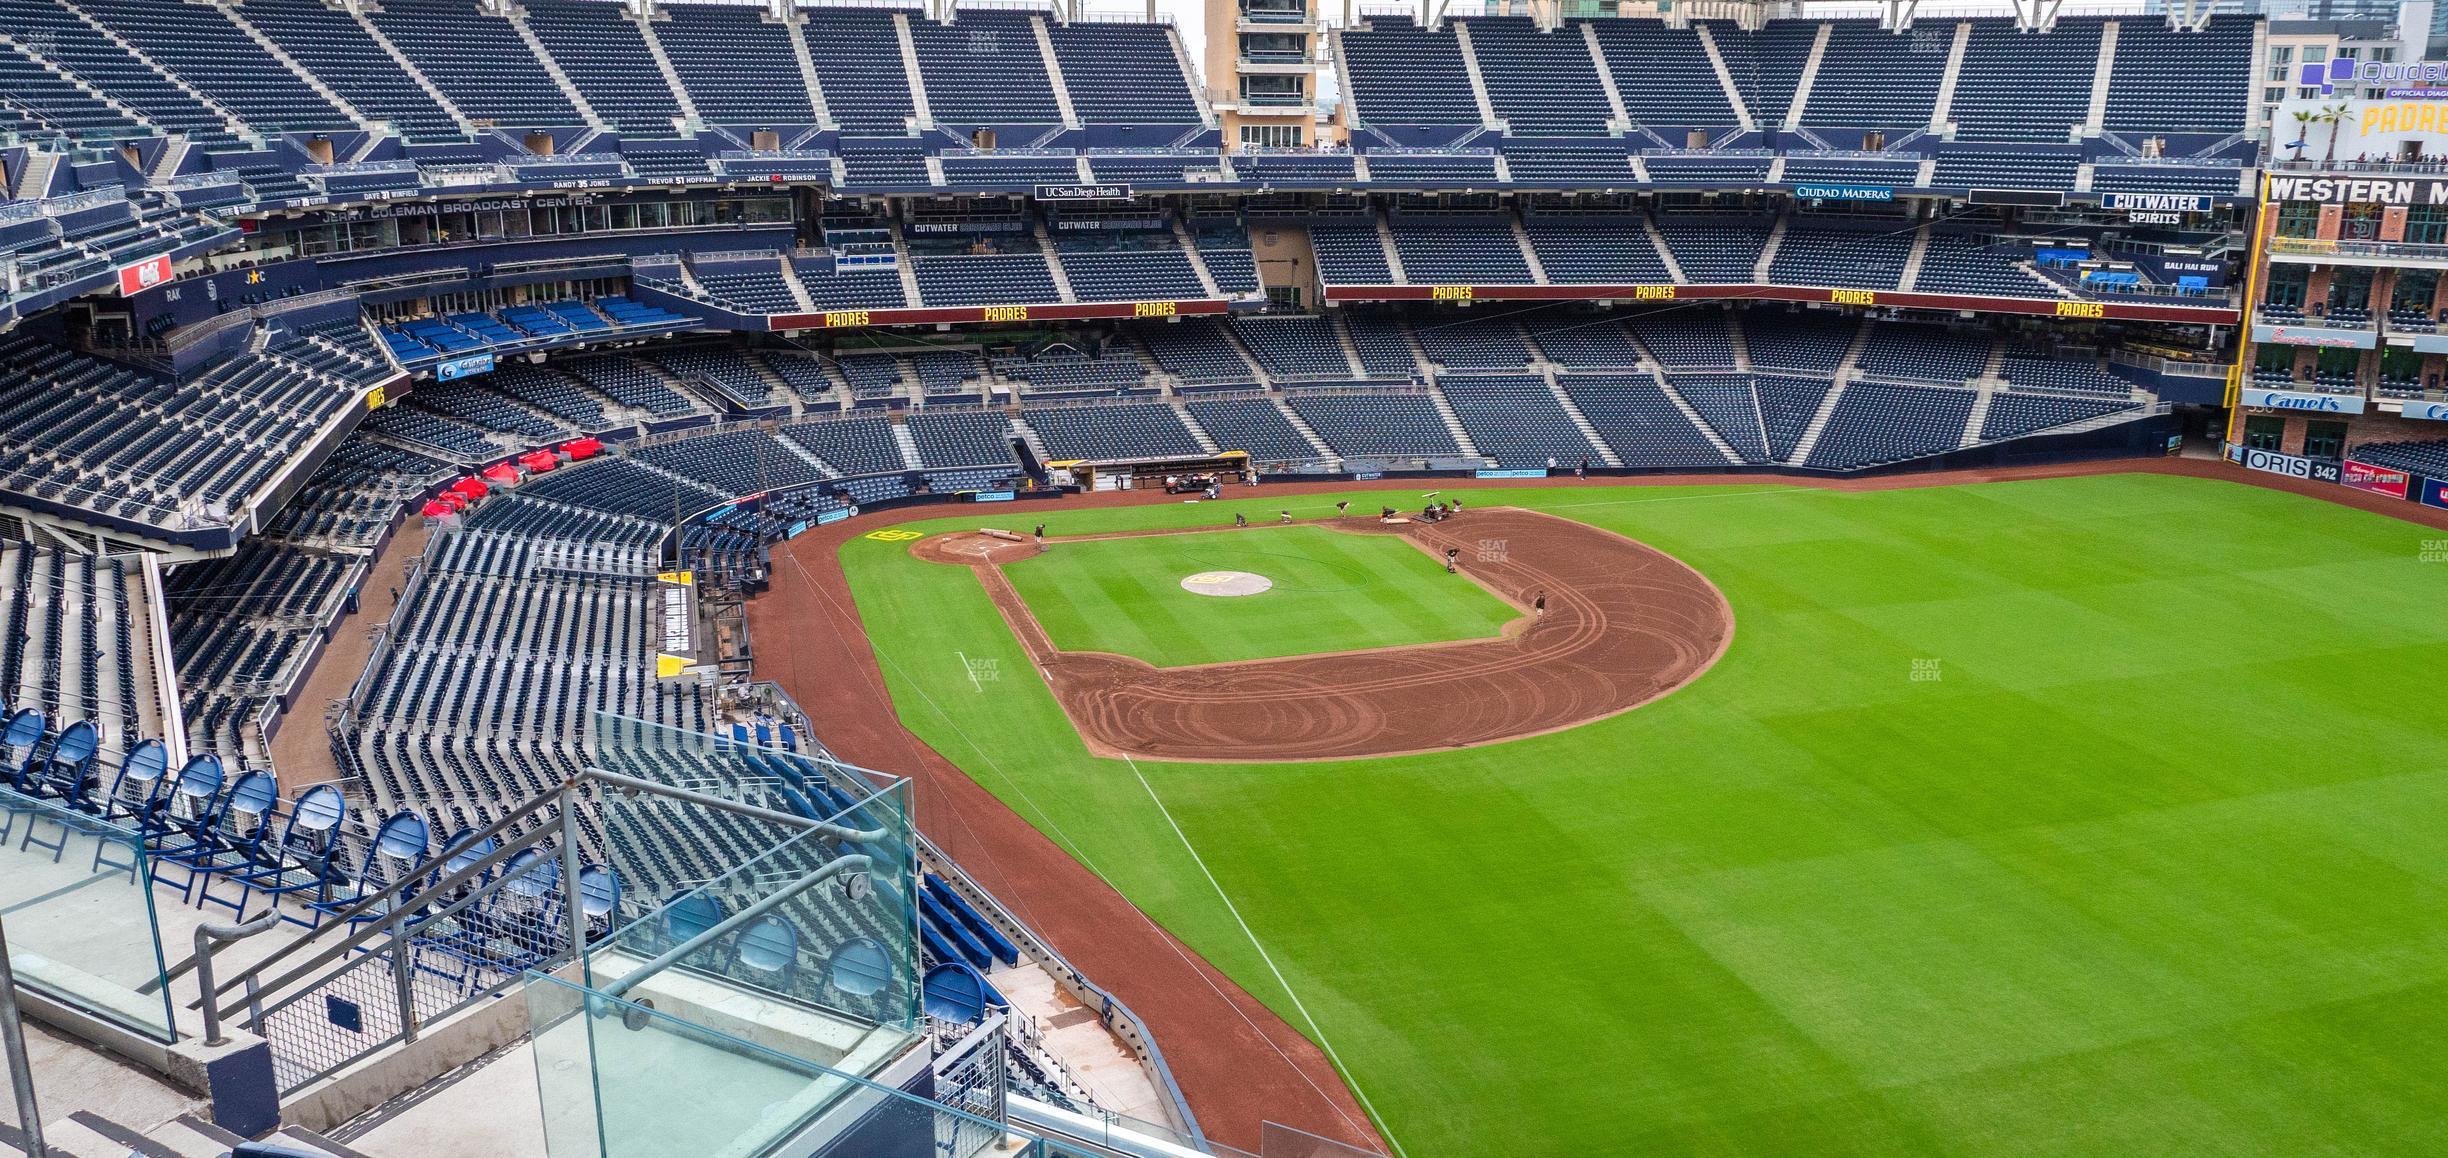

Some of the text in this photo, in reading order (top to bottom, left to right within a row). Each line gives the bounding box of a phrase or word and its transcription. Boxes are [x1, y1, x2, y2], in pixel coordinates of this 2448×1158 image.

[578, 180, 588, 188] 35
[648, 176, 717, 185] TREVOR 51 HOFFMAN
[364, 192, 380, 200] DAVE
[391, 190, 418, 198] WINFIELD
[1045, 187, 1120, 198] UC San Diego Health
[1797, 186, 1890, 200] CIUDAD MADERAS
[2270, 178, 2415, 204] WESTERN
[2114, 194, 2200, 210] CUTWATER
[322, 196, 593, 223] JERRY COLEMAN BROADCAST CENTER
[2129, 212, 2180, 224] SPIRITS
[915, 224, 958, 232] CUTWATER
[1058, 221, 1100, 230] CUTWATER
[2164, 262, 2218, 272] BALI HAI RUM
[166, 288, 182, 302] RAK
[1432, 286, 1472, 299] PADRES
[1636, 286, 1674, 298] PADRES
[1832, 290, 1874, 304] PADRES
[985, 306, 1027, 321] PADRES
[1136, 302, 1176, 316] PADRES
[2056, 302, 2104, 318] PADRES
[826, 311, 869, 327] PADRES
[2264, 392, 2340, 412] Canel's
[2251, 452, 2308, 476] ORIS
[2315, 465, 2337, 480] 342
